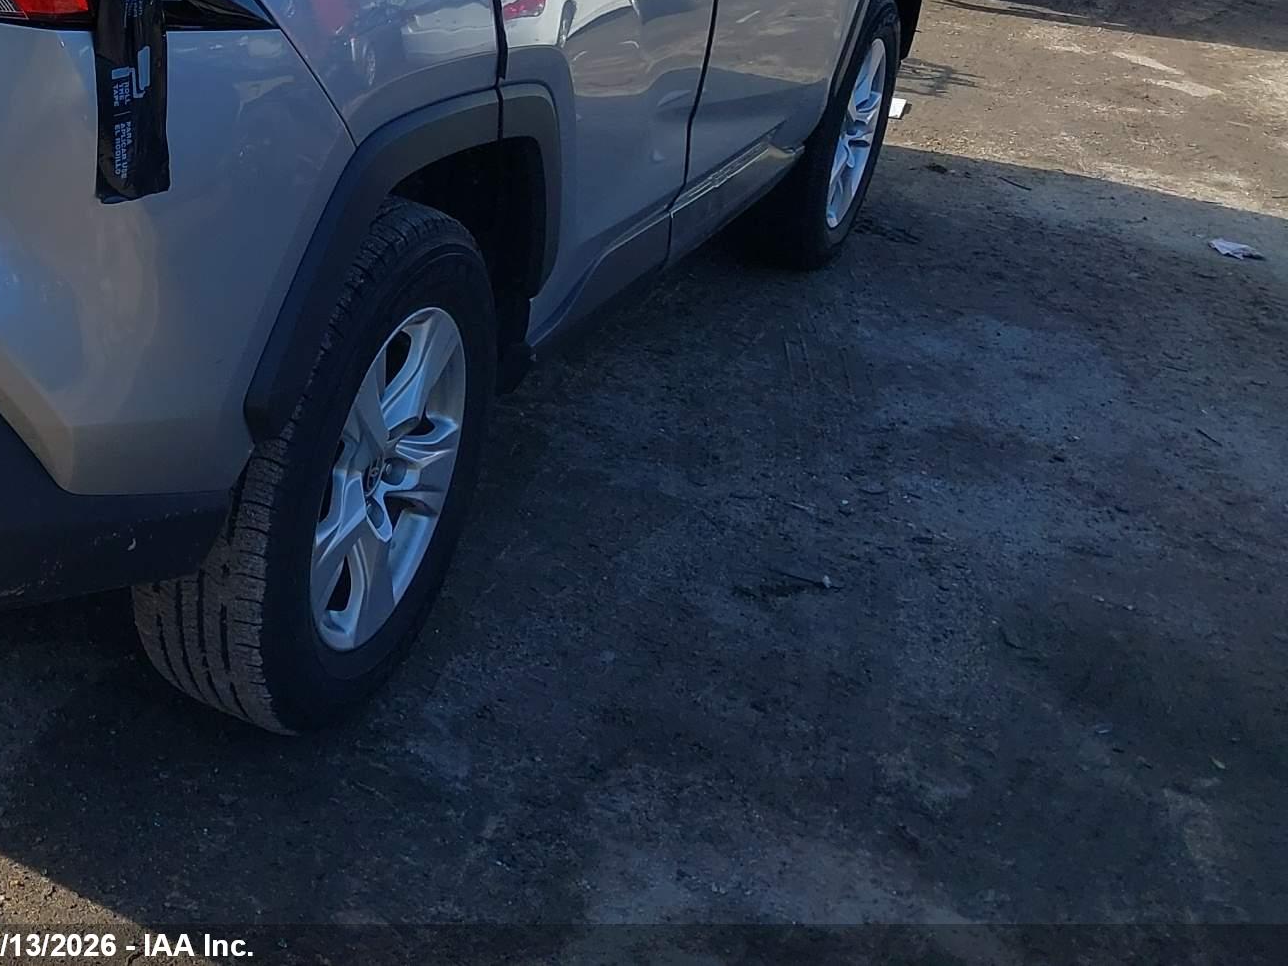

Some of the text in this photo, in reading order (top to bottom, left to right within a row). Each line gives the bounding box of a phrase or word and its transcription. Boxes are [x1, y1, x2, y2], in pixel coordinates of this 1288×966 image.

[112, 83, 120, 107] TAPE
[124, 81, 132, 106] ROLL
[114, 124, 119, 136] EL
[120, 123, 128, 160] APLICAR
[125, 121, 133, 145] PARA
